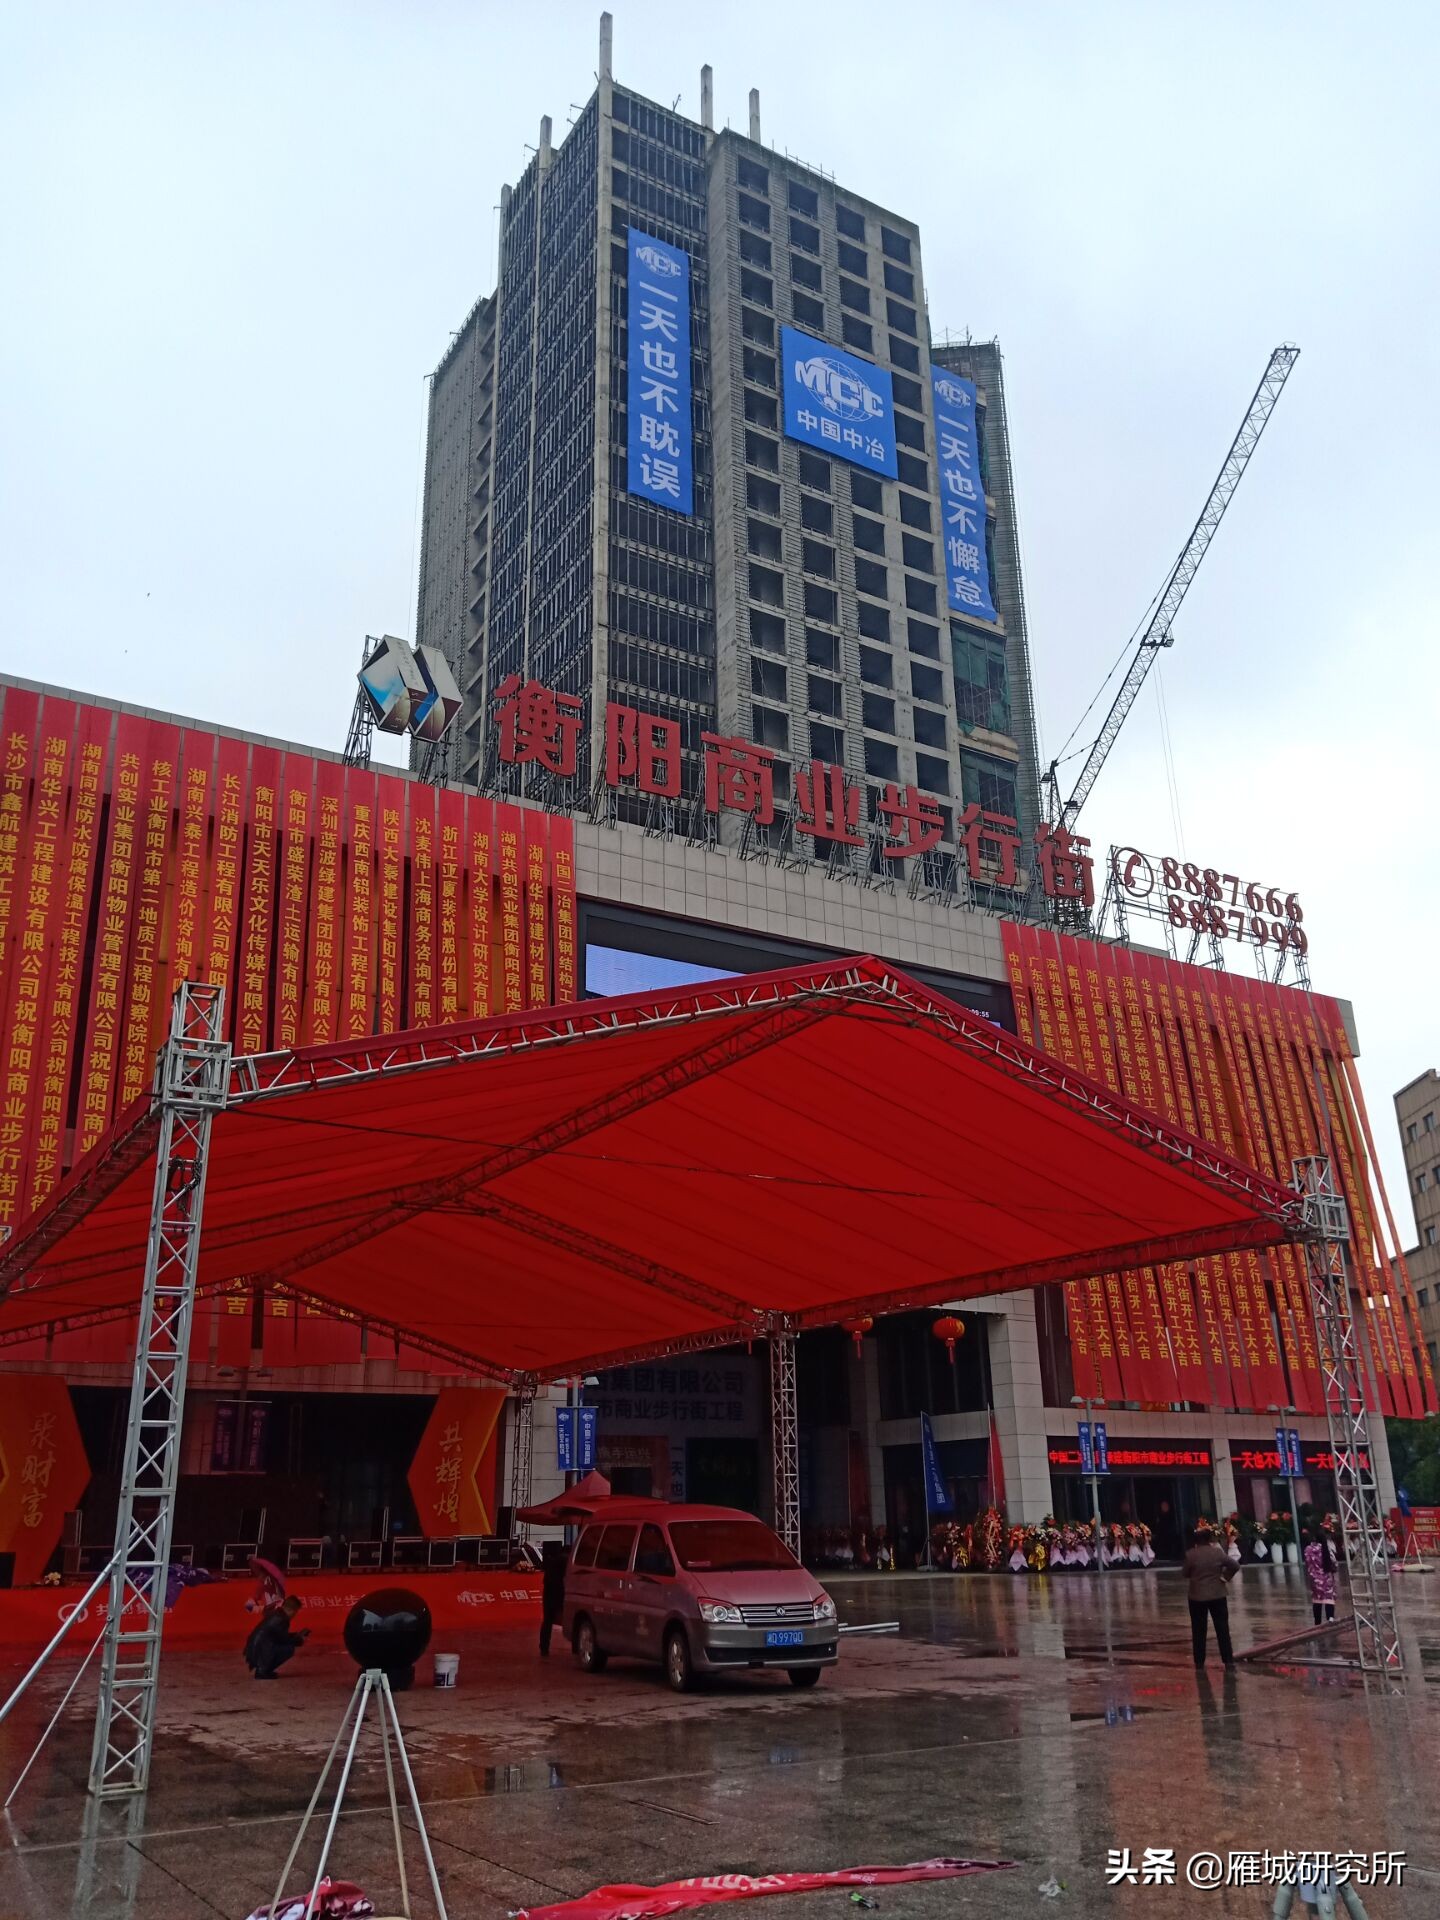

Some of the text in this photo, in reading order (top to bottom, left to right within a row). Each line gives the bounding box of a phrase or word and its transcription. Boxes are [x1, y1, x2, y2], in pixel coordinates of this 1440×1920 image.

[636, 247, 682, 277] MCC
[639, 280, 681, 498] 一天也不耽误
[795, 361, 884, 418] MCC
[797, 410, 885, 462] 中国中冶
[934, 379, 972, 407] MCC
[939, 414, 984, 608] 一天也不懈怠
[494, 674, 1095, 907] 衡阳商业步行街
[121, 760, 172, 1112] 核工业衡阳市第二地质工程勘察院祝衡阳
[243, 786, 275, 1052] 衡阳市天天乐文化传媒有限公司
[1162, 857, 1304, 923] 8887666
[1167, 894, 1309, 955] 8887999
[1066, 965, 1099, 1081] 衡阳市湘运房地产
[1122, 976, 1158, 1115] 深圳市晶艺装饰设计工
[21, 1411, 57, 1528] 聚财富
[432, 1420, 463, 1523] 共辉煌
[1231, 1451, 1295, 1469] 一天也不
